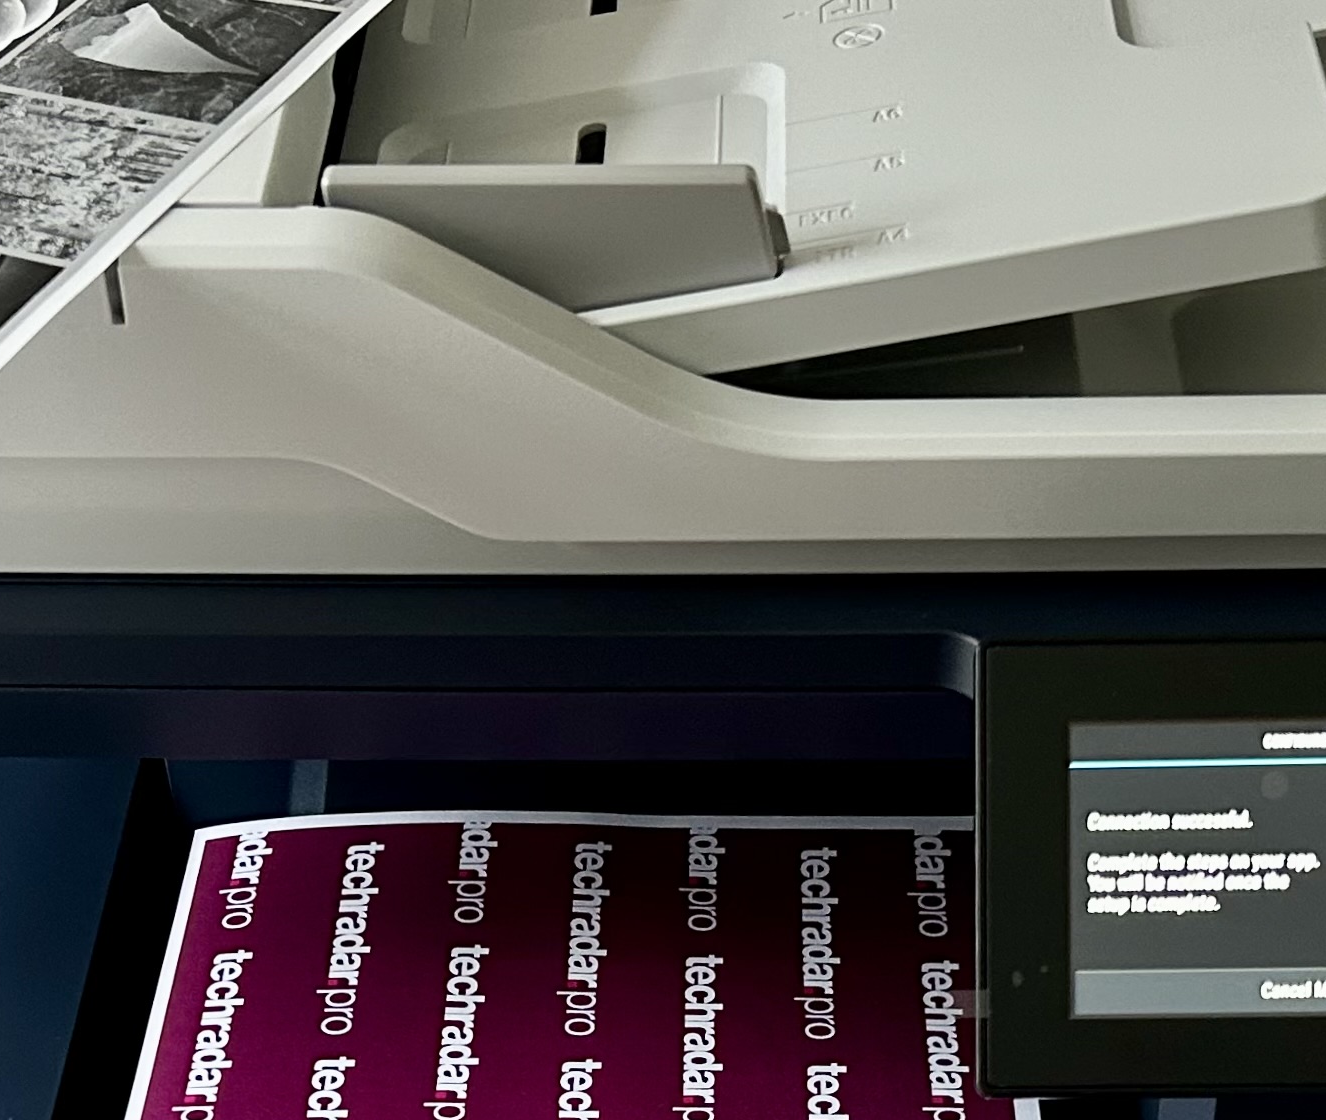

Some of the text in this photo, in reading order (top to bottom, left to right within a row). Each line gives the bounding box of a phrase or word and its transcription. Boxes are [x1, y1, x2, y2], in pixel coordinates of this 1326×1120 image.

[1087, 809, 1253, 831] Connection successful.
[1087, 853, 1158, 874] Complete
[1159, 852, 1185, 871] the
[1229, 854, 1250, 870] on
[1251, 854, 1285, 872] your
[1287, 853, 1320, 872] app.
[1087, 872, 1290, 892] You will be notified once the
[1087, 893, 1220, 915] setup is complete.
[316, 841, 385, 1035] techradar.pro
[556, 841, 612, 1036] techradar.pro
[793, 847, 841, 1039] techradar.pro
[1260, 980, 1312, 999] Cancel
